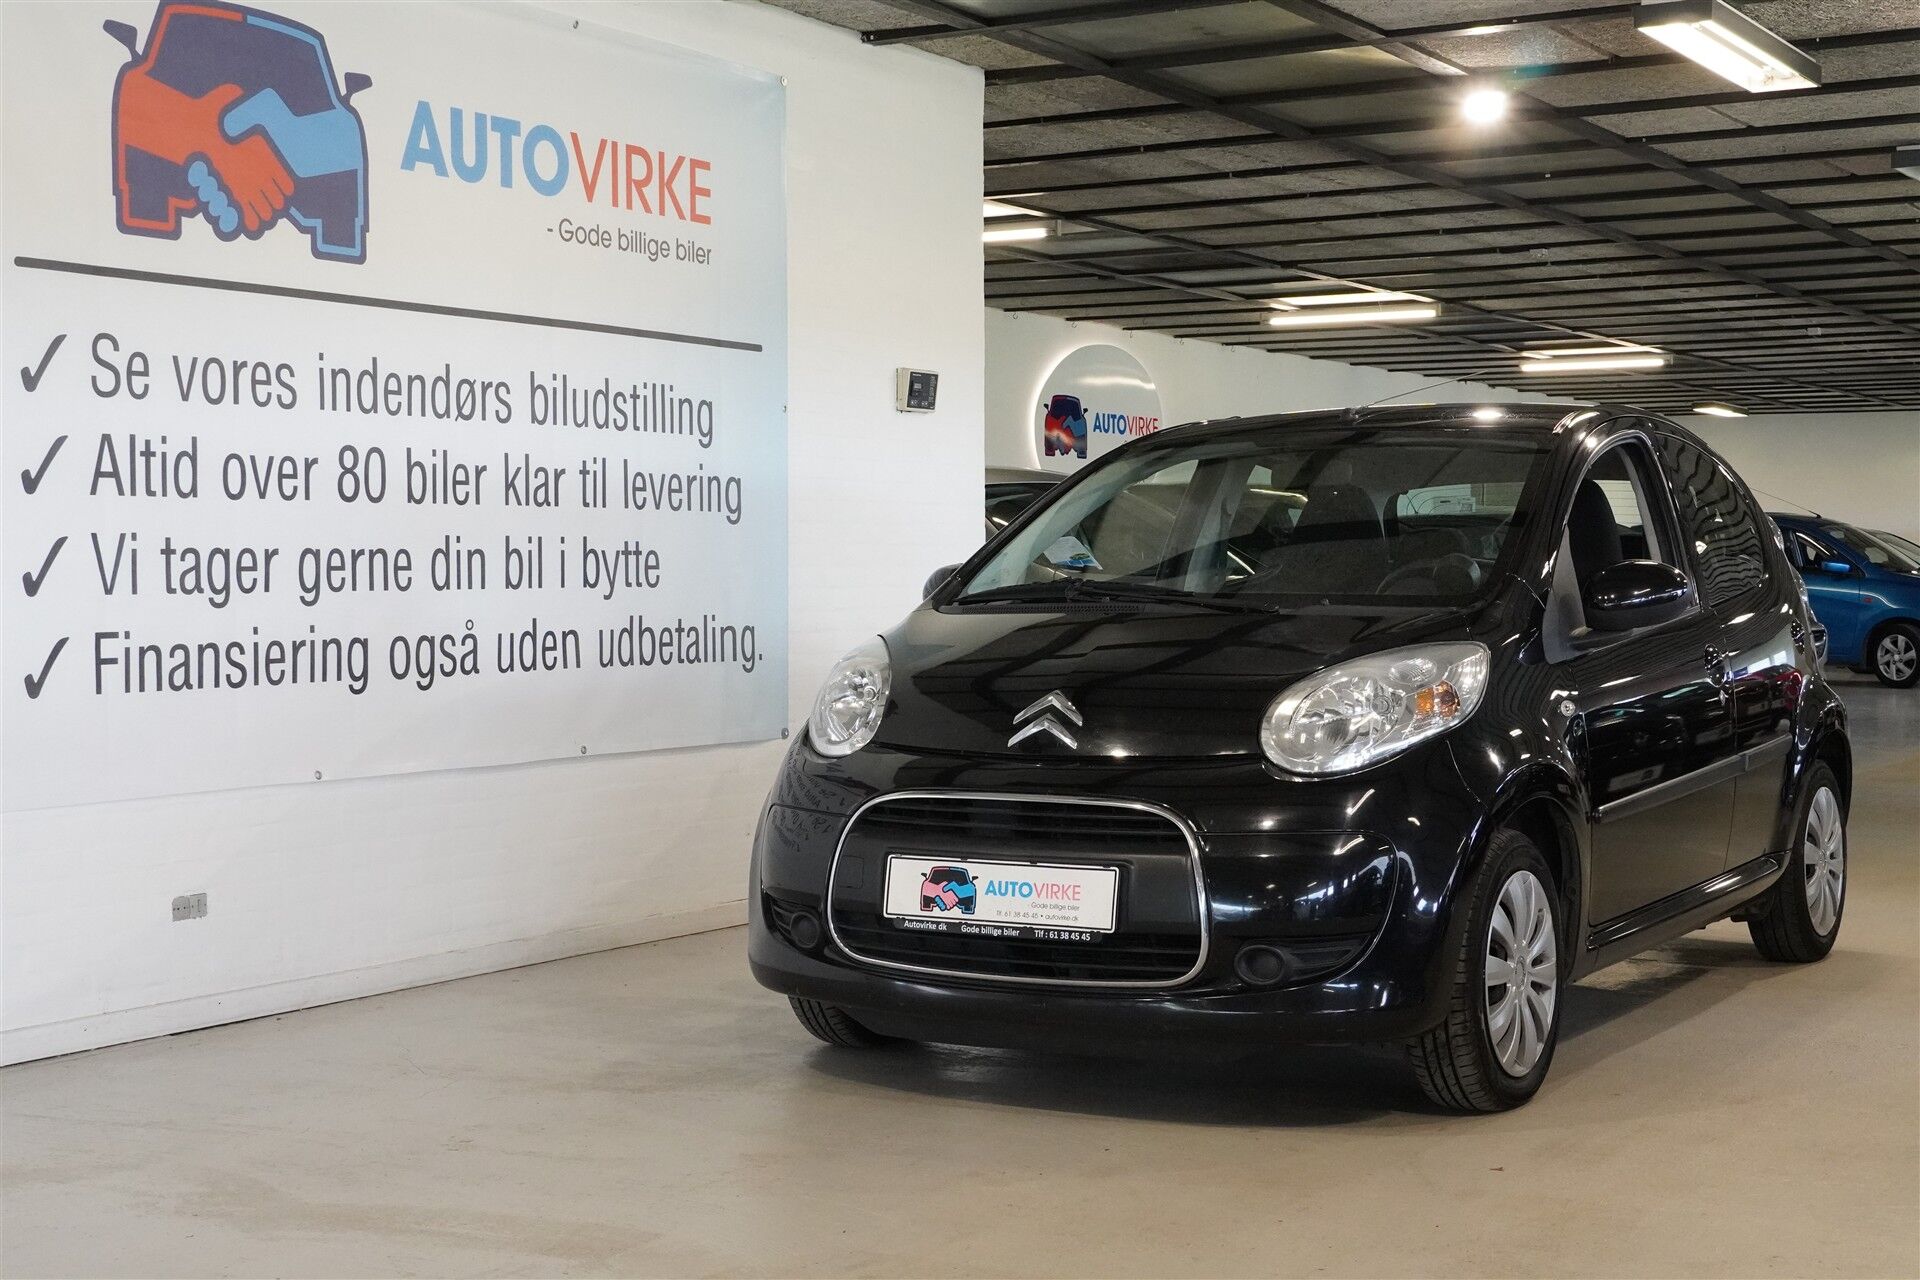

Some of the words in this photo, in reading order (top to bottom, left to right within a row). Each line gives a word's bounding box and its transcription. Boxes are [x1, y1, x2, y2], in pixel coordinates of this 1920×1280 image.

[400, 100, 712, 225] AUTOVIRKE
[558, 217, 613, 250] Gode
[617, 227, 671, 263] billige
[675, 237, 712, 266] biler
[91, 333, 150, 400] Se
[171, 355, 297, 411] vores
[318, 353, 513, 422] indendørs
[529, 371, 714, 448] biludstilling
[1093, 412, 1159, 436] AUTOVIRKE
[89, 434, 199, 499] Altid
[222, 452, 319, 502] over
[336, 444, 387, 504] 80
[405, 447, 488, 506] biler
[503, 453, 567, 508] klar
[578, 457, 607, 509] til
[623, 459, 742, 525] levering
[91, 532, 138, 596] Vi
[160, 537, 280, 609] tager
[298, 547, 413, 607] gerne
[430, 535, 486, 592] din
[504, 535, 543, 591] bil
[560, 536, 566, 589] i
[582, 536, 661, 600] bytte
[94, 625, 369, 696] Finansiering
[389, 619, 481, 691] også
[497, 617, 582, 674] uden
[598, 614, 764, 674] udbetaling.
[984, 879, 1081, 901] AUTOVIRKE
[904, 920, 937, 931] Autovirke
[961, 924, 980, 934] Gode
[981, 926, 1002, 937] billige
[1003, 927, 1020, 937] biler
[1049, 930, 1059, 939] 61
[1060, 931, 1070, 940] 38
[1071, 932, 1080, 941] 45
[1081, 933, 1091, 941] 45
